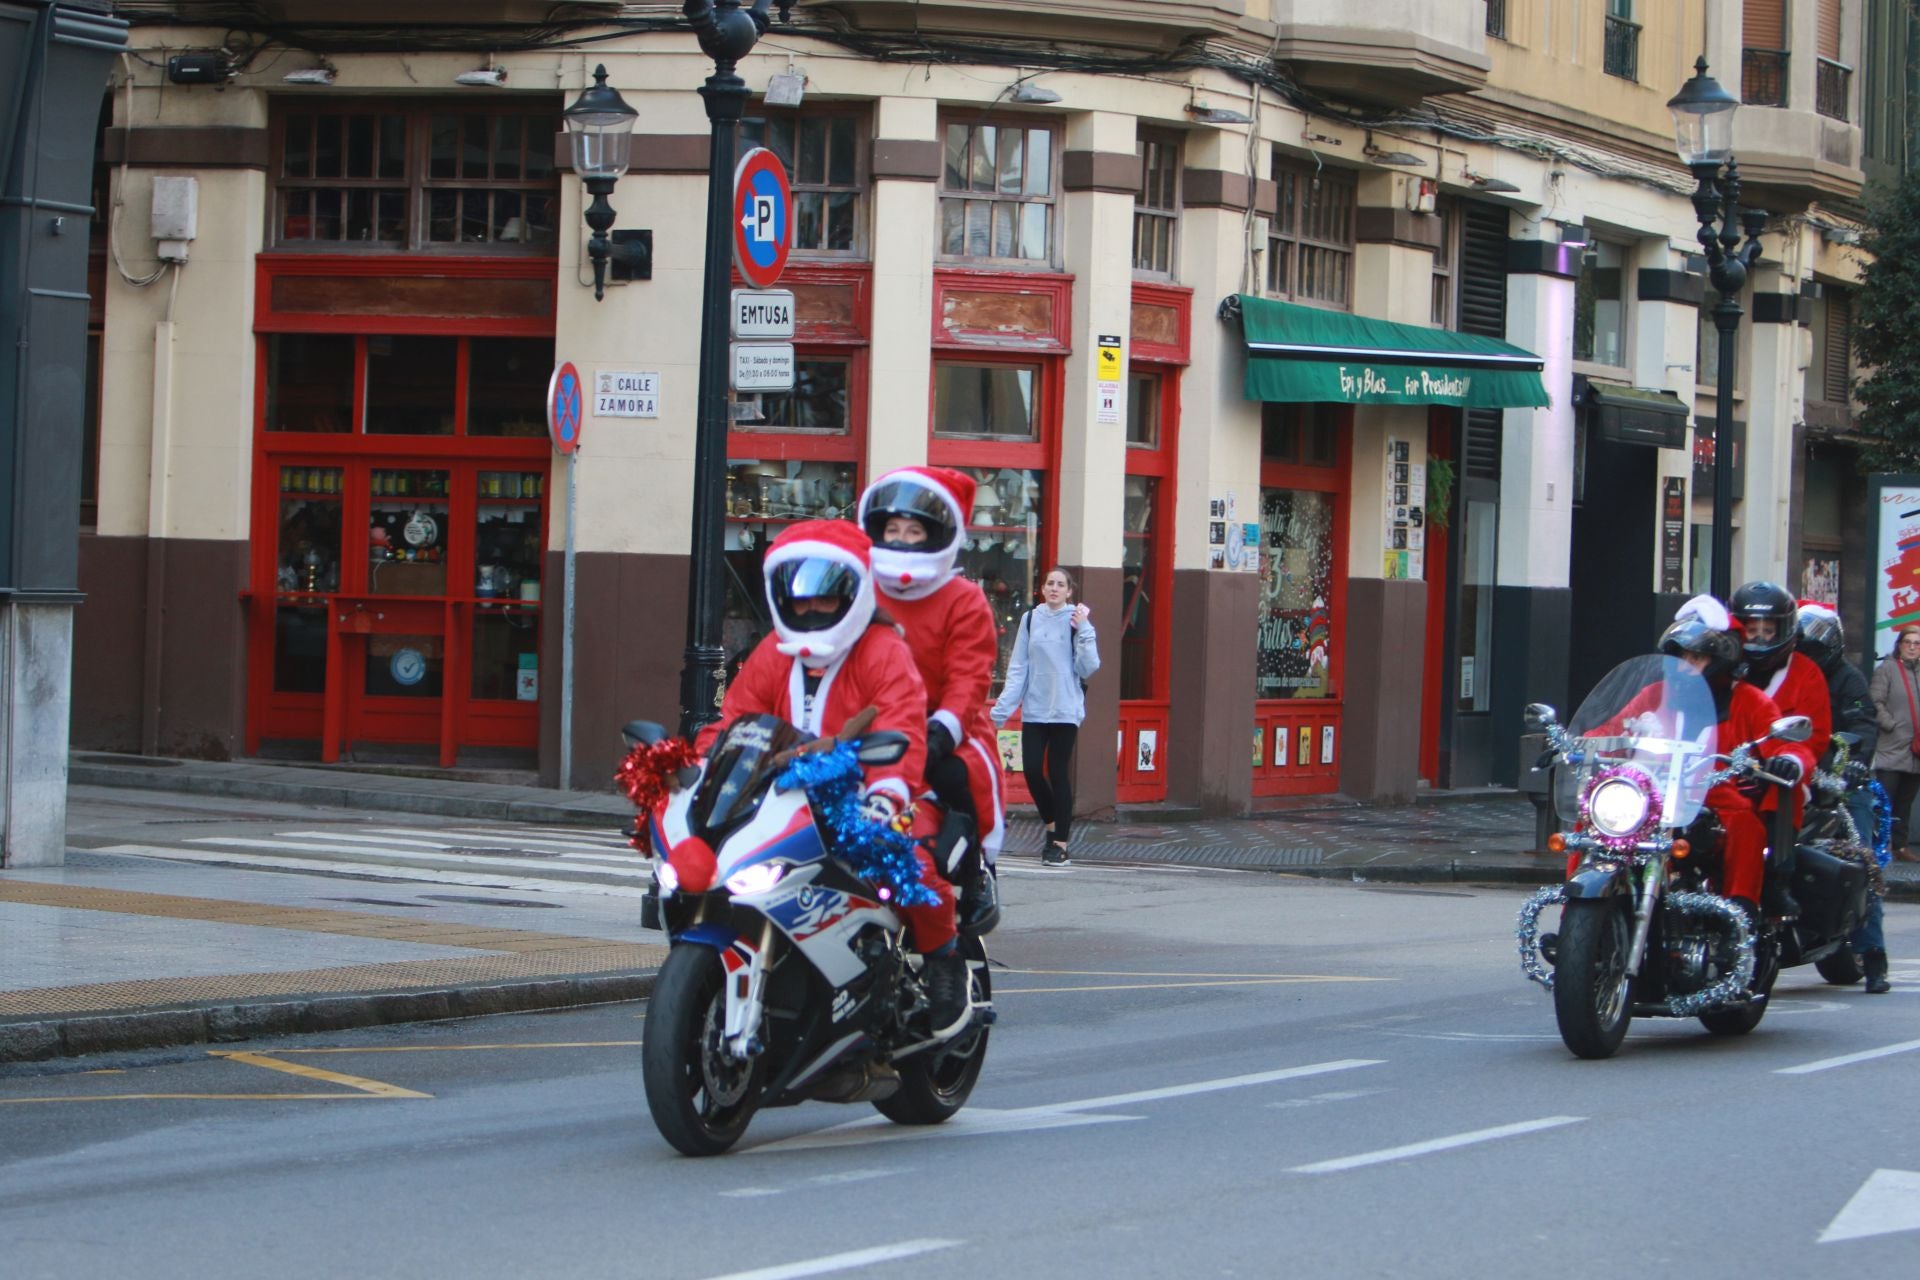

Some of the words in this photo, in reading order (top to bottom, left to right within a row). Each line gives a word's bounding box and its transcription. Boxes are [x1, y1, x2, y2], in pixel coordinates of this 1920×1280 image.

[758, 200, 771, 237] P
[741, 305, 789, 325] EMTUSA
[739, 356, 750, 364] TAXI
[617, 378, 651, 391] CALLE
[1339, 366, 1355, 399] Epi
[1356, 376, 1363, 399] y
[600, 398, 654, 412] ZAMORA
